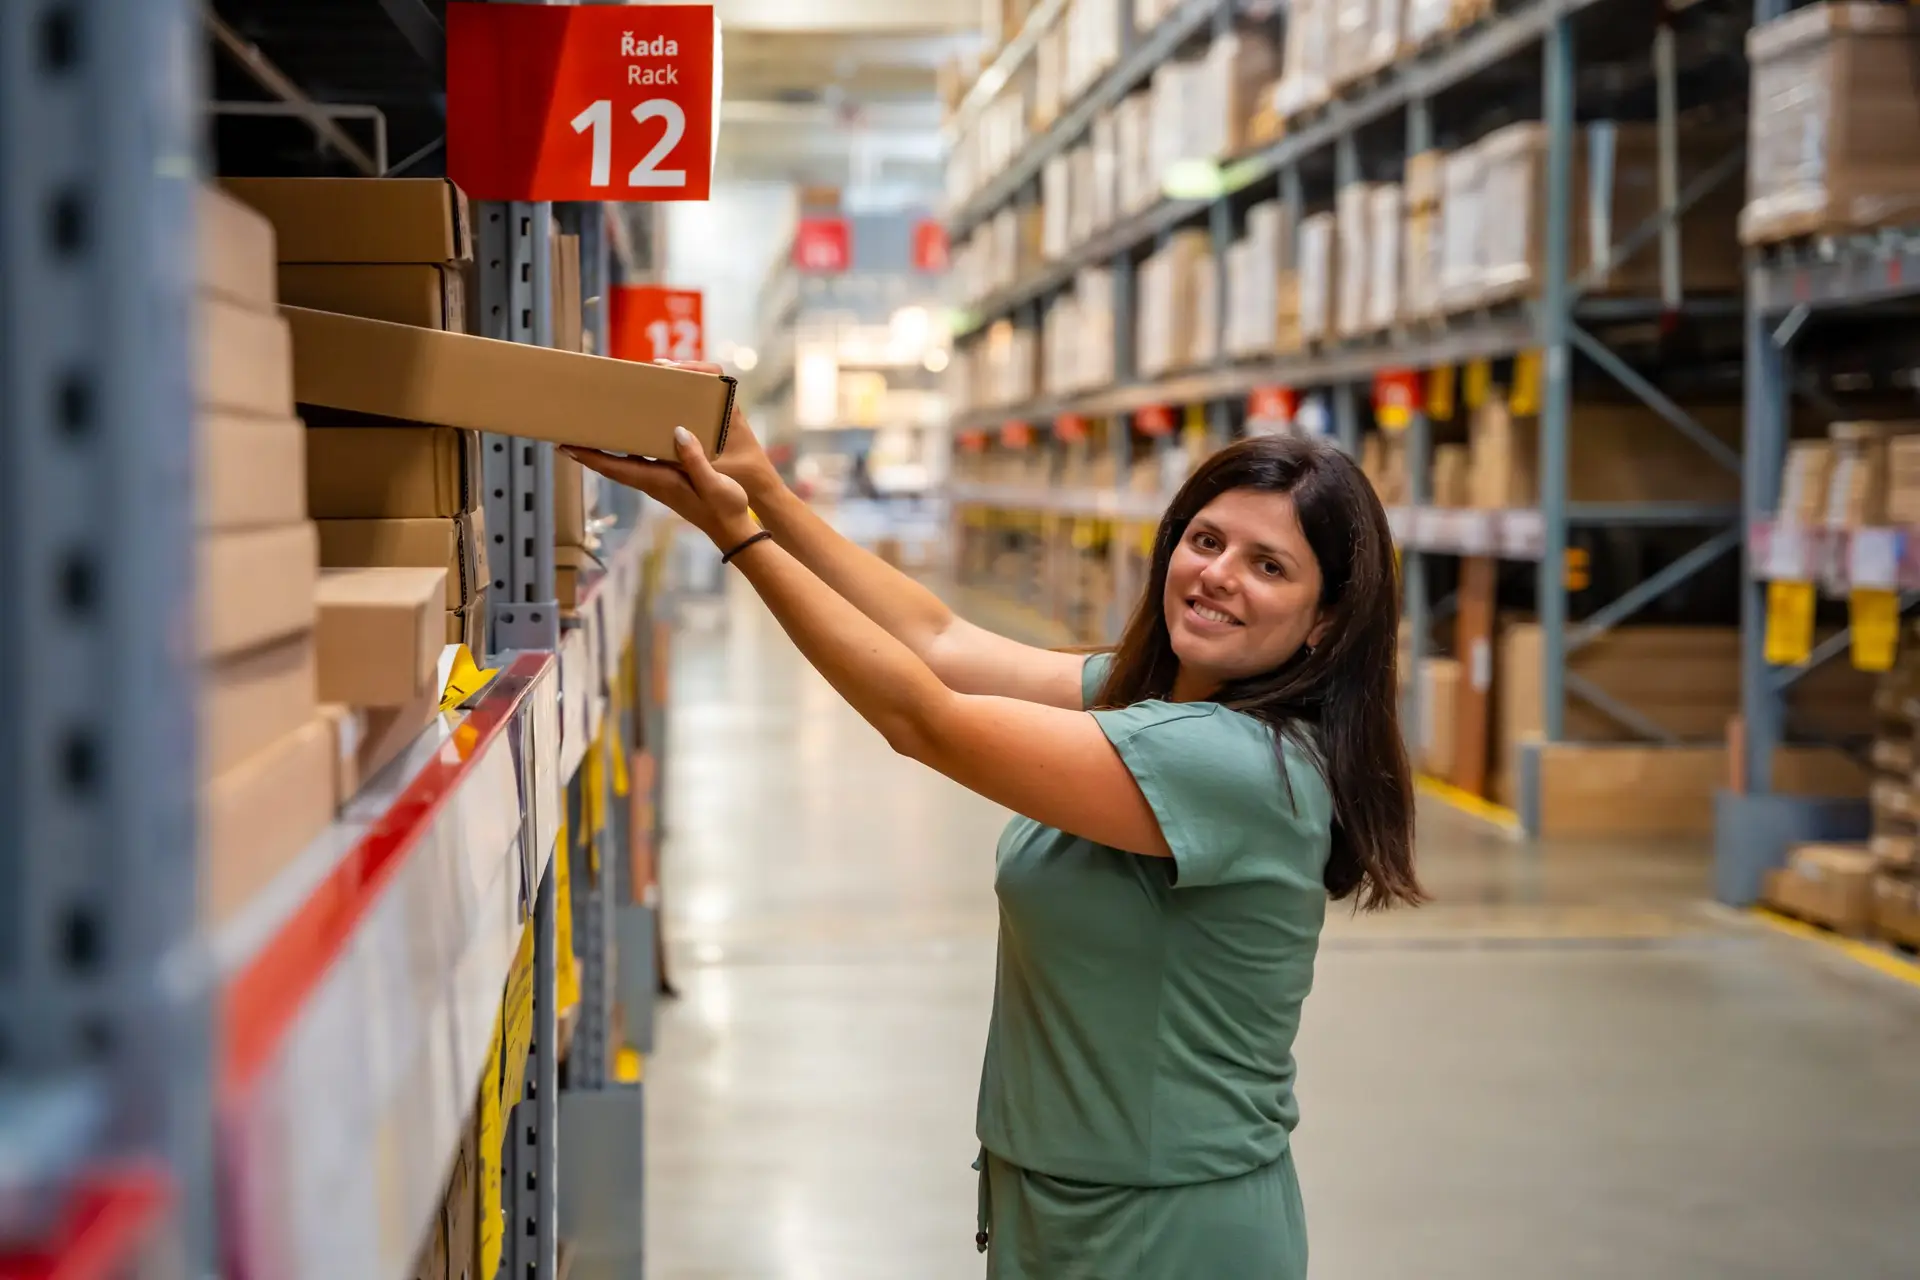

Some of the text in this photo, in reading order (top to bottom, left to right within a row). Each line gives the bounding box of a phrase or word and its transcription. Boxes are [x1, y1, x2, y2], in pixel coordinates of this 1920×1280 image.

[621, 31, 678, 57] Řada
[628, 63, 678, 85] Rack
[570, 98, 687, 187] 12
[646, 319, 698, 361] 12
